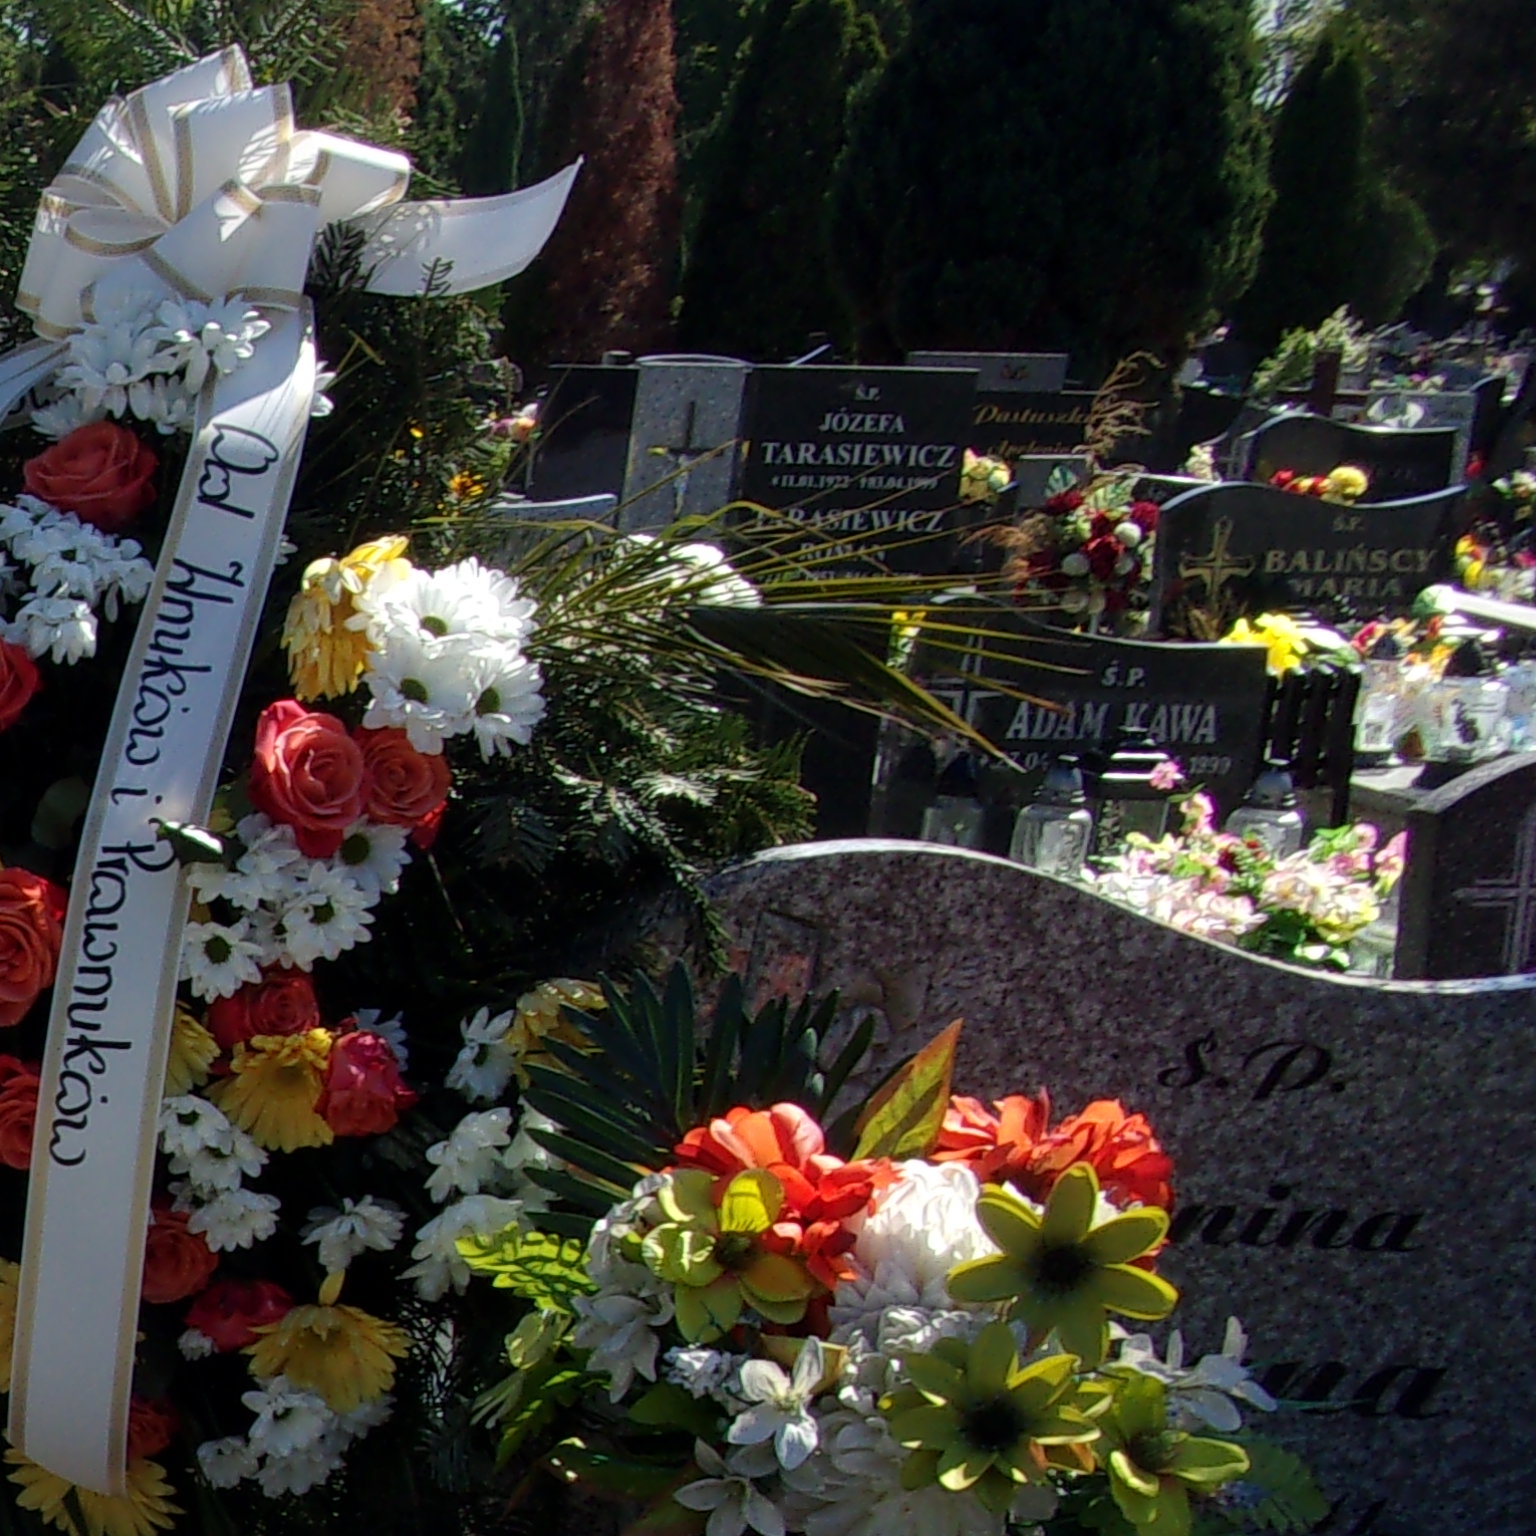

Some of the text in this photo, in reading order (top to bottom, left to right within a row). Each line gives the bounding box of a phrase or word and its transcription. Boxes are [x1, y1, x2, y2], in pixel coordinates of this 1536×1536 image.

[817, 407, 906, 434] JÓZEFA
[196, 422, 279, 519] Od
[760, 440, 956, 469] TARASIEWICZ
[1264, 542, 1439, 574] BALIŃSCY
[1005, 700, 1218, 744] ADAM KAWA
[48, 817, 179, 1167] Prawnuków
